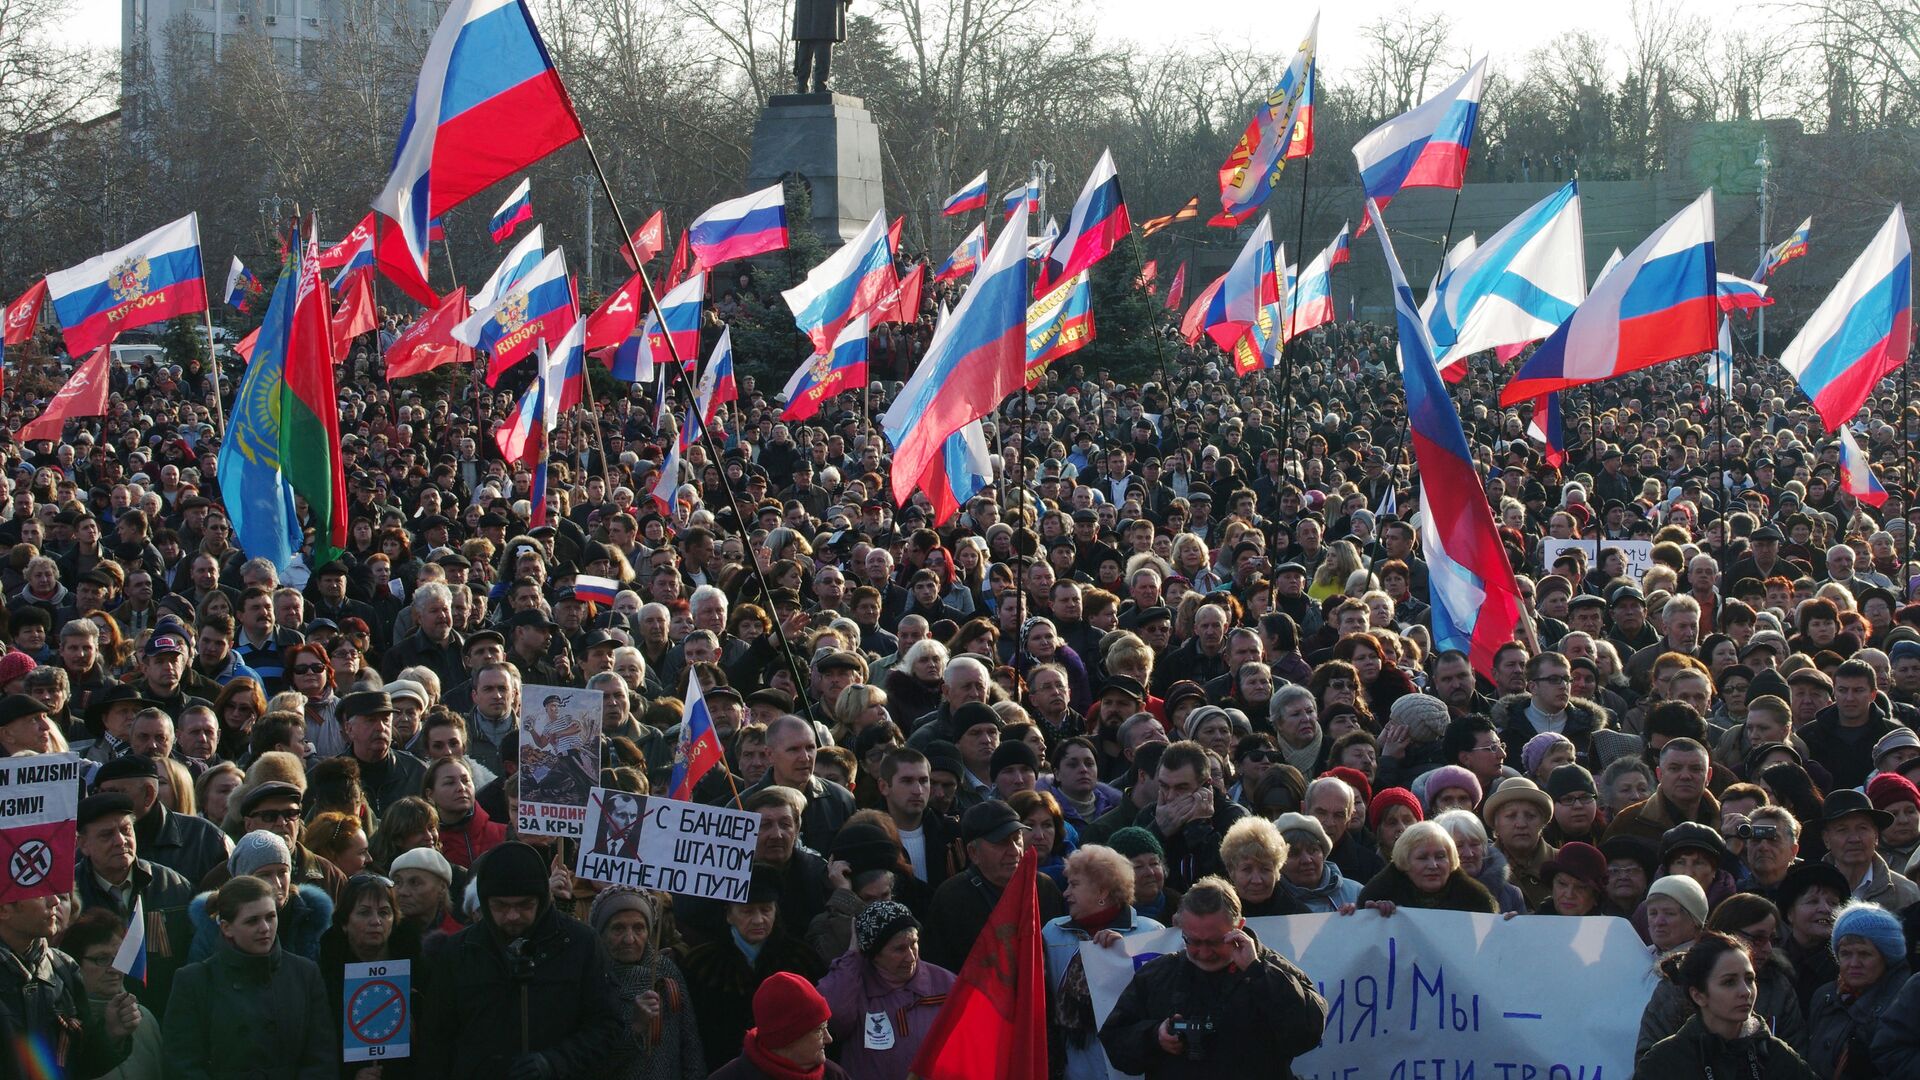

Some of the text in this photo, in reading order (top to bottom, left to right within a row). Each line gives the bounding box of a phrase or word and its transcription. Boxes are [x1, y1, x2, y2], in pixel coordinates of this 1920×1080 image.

[0, 762, 78, 786] N NAZISM!
[520, 804, 586, 820] ЗА РОДИН
[656, 805, 758, 841] С БАНДЕР-
[519, 817, 583, 834] ЗА КРЫ
[673, 839, 754, 872] ШТАТОМ
[581, 855, 749, 901] НАМ НЕ ПО ПУТИ
[369, 967, 387, 976] NO
[1410, 963, 1479, 1031] Мы
[369, 1046, 386, 1056] EU
